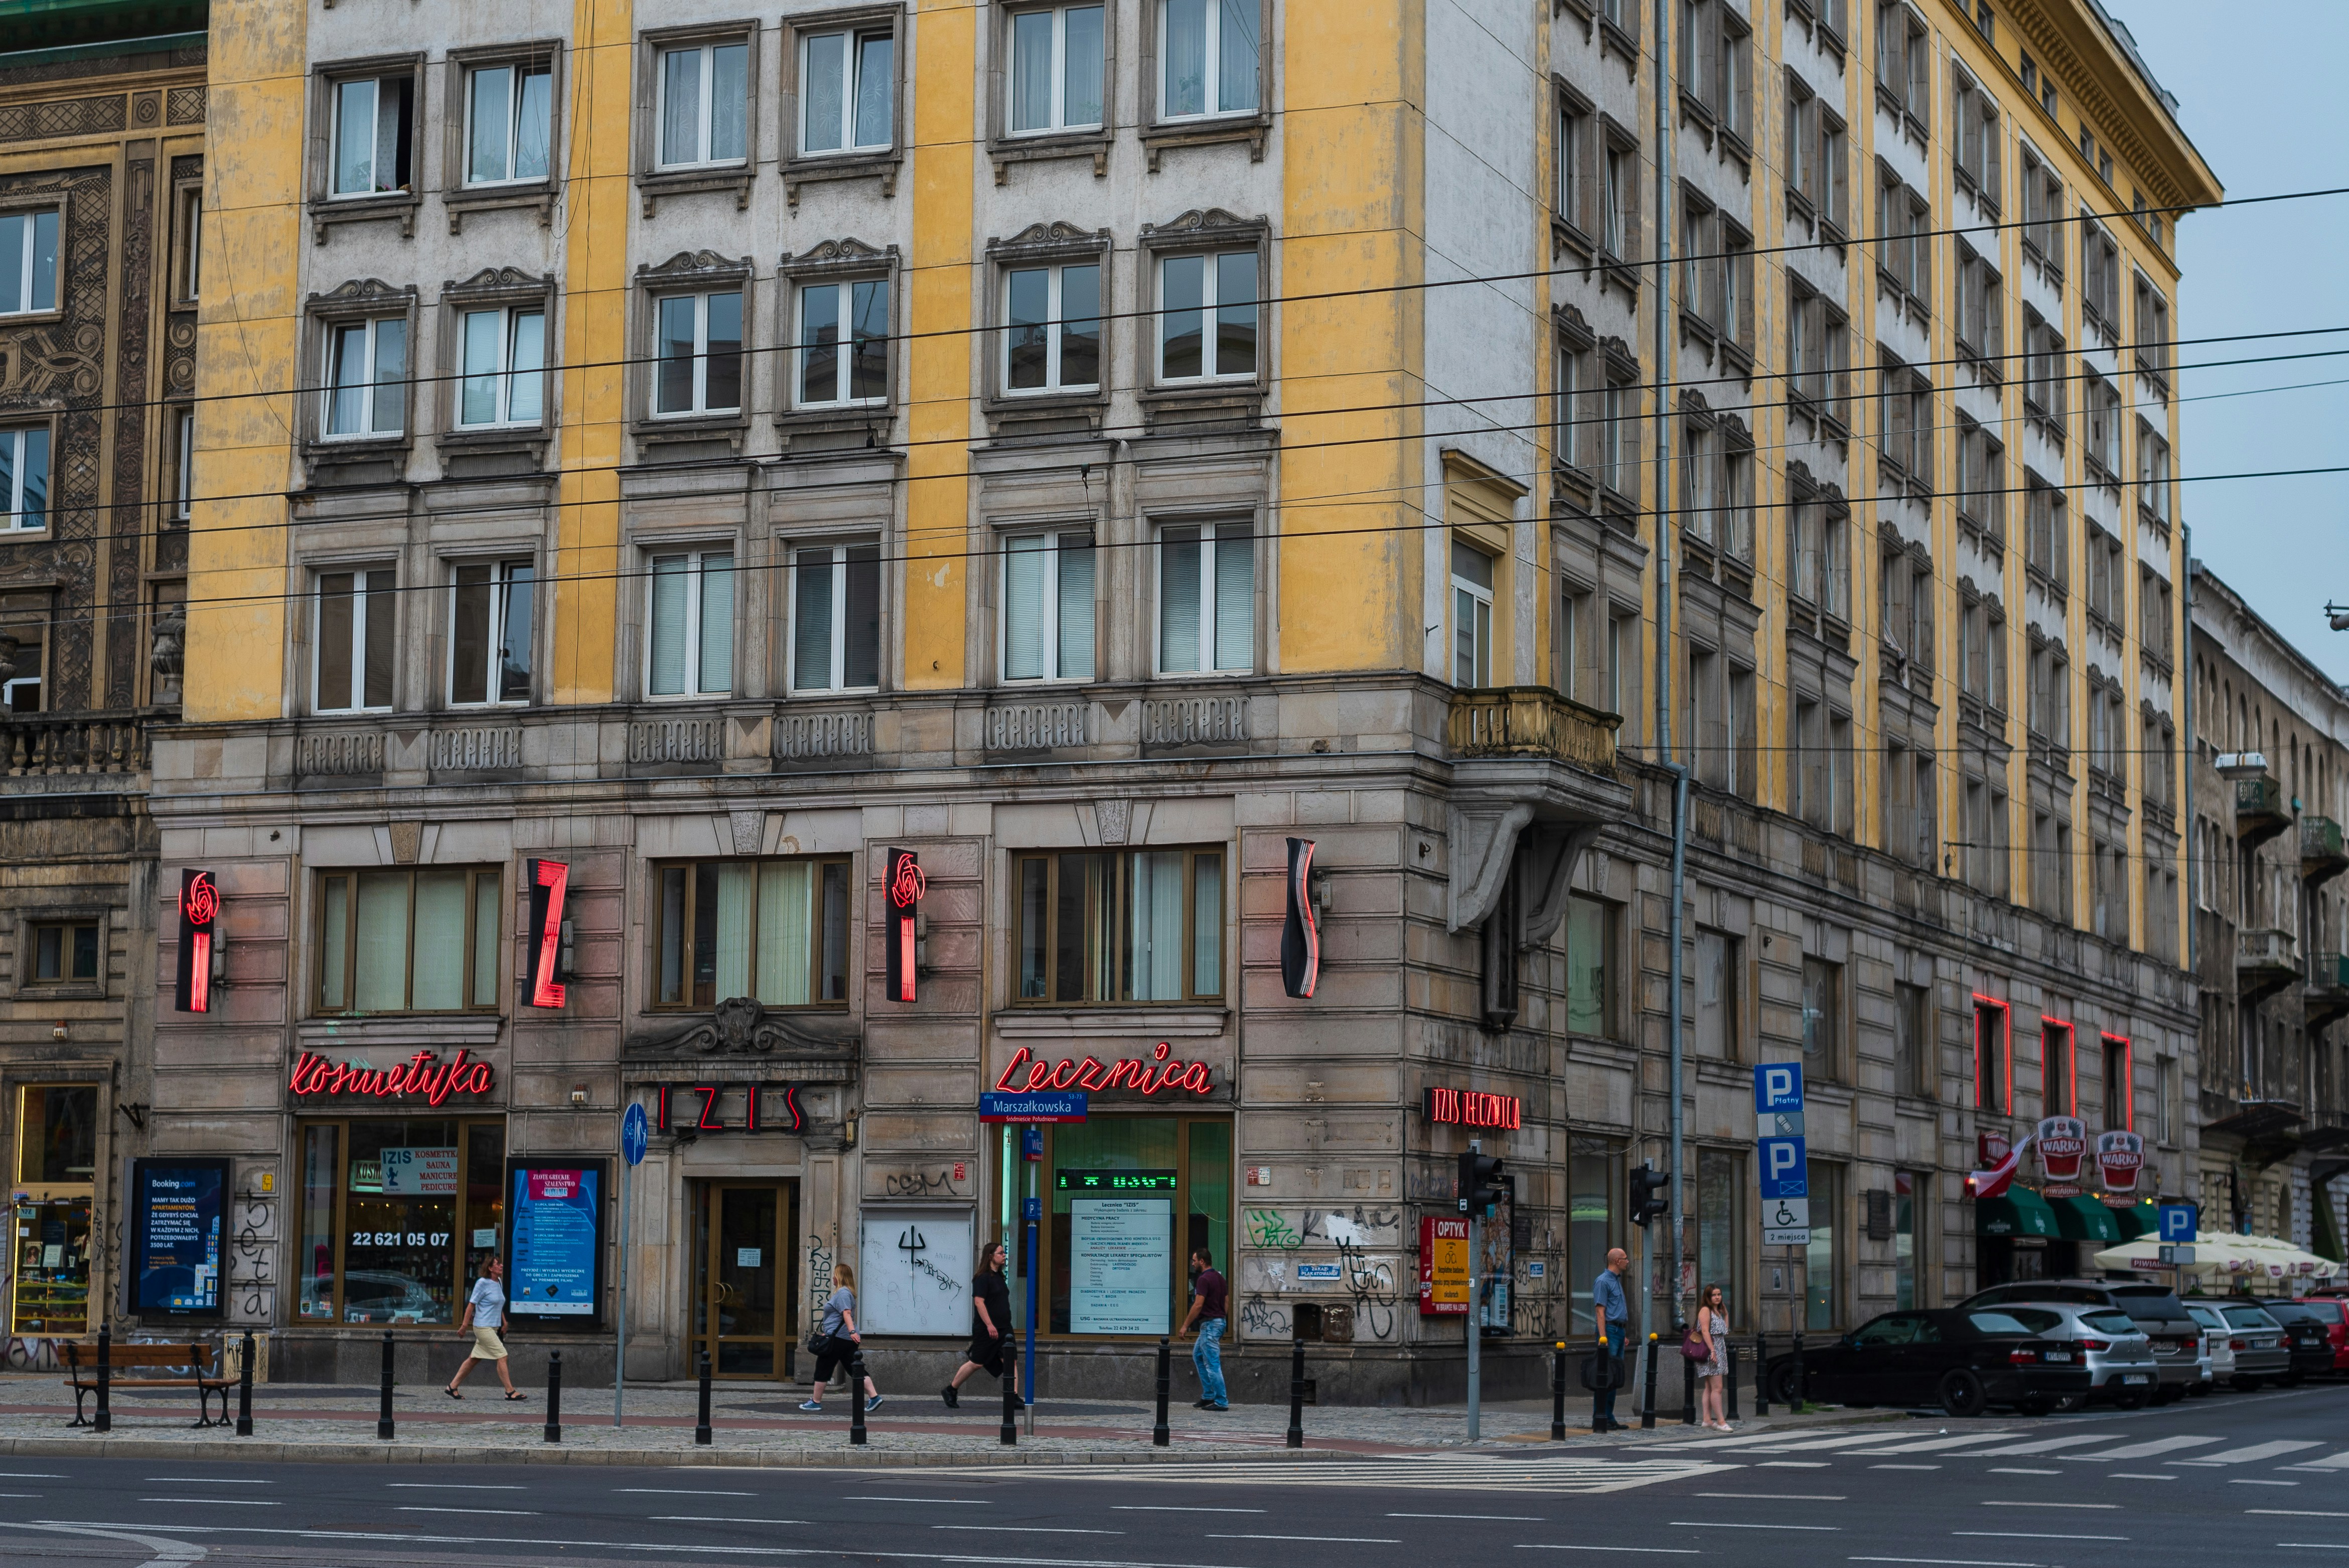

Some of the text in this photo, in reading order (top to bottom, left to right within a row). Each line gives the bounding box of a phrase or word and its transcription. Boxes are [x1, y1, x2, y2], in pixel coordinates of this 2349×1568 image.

[996, 1042, 1210, 1094] Lecznica
[290, 1049, 494, 1107] Kosmetyka
[1766, 1069, 1792, 1106] P
[657, 1082, 809, 1135] IZIS
[994, 1100, 1071, 1112] Marszałkowska
[2042, 1140, 2081, 1152] WARKA
[382, 1151, 411, 1165] IZIS
[1770, 1143, 1796, 1180] P
[2102, 1154, 2138, 1165] WARKA
[152, 1180, 195, 1189] Booking.com
[1030, 1204, 1034, 1214] P
[1438, 1221, 1465, 1237] OPTYK
[2168, 1210, 2187, 1237] P
[353, 1232, 449, 1246] 22 621 05 07
[1778, 1233, 1806, 1241] miejsca
